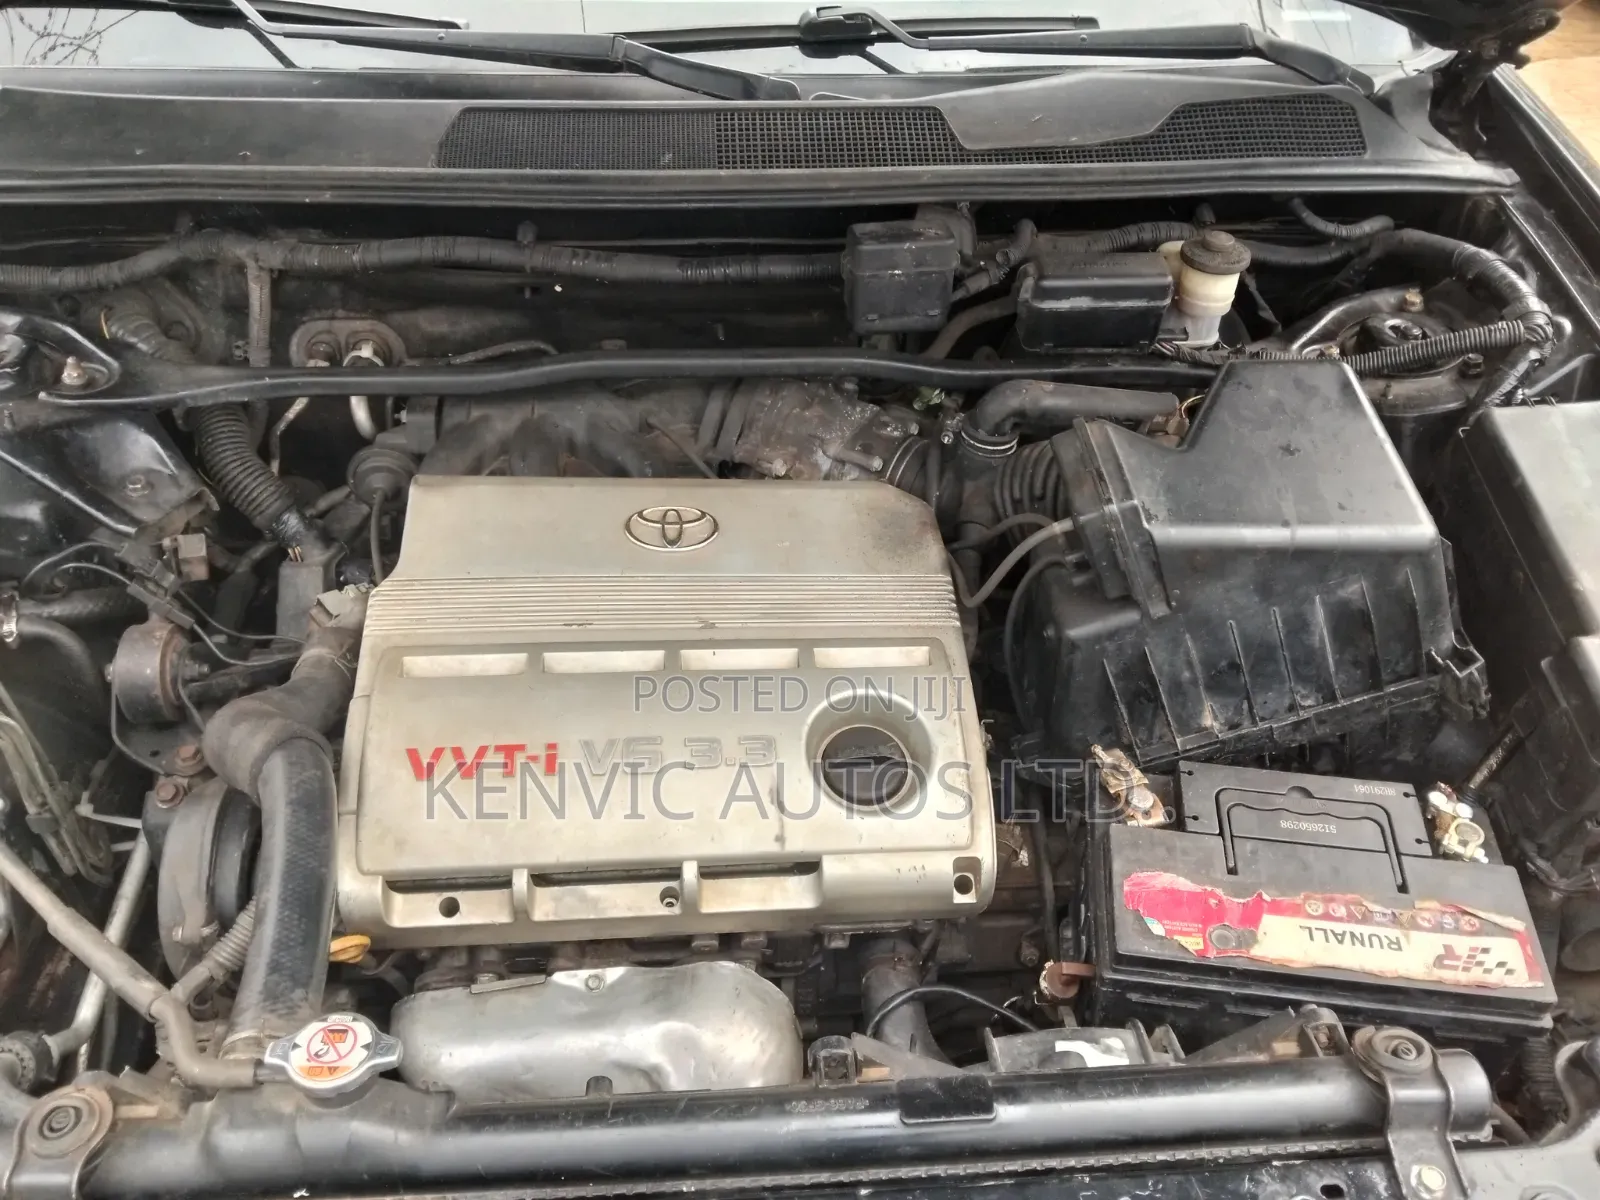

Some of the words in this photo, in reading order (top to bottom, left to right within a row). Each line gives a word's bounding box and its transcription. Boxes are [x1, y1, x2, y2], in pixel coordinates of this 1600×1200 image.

[405, 742, 560, 782] VVT-i
[578, 735, 663, 776] V6
[684, 734, 778, 769] 3.3
[1299, 923, 1404, 954] RUNALL
